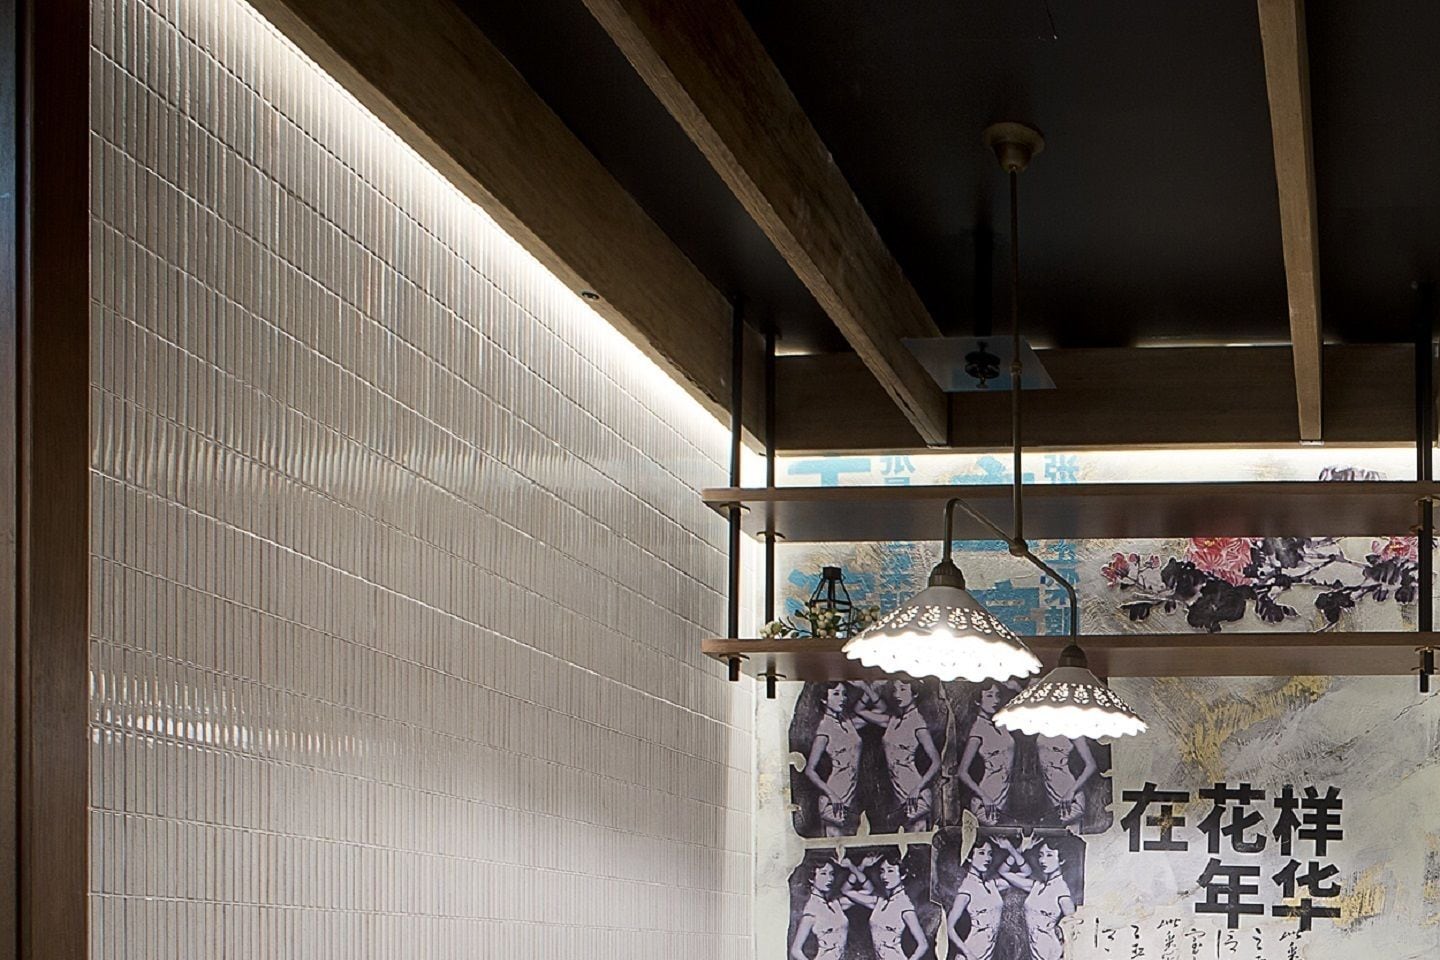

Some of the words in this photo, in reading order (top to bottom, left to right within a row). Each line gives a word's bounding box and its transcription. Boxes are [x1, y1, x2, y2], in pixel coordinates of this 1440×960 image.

[1119, 781, 1344, 857] 在花样
[1194, 857, 1342, 932] 年华
